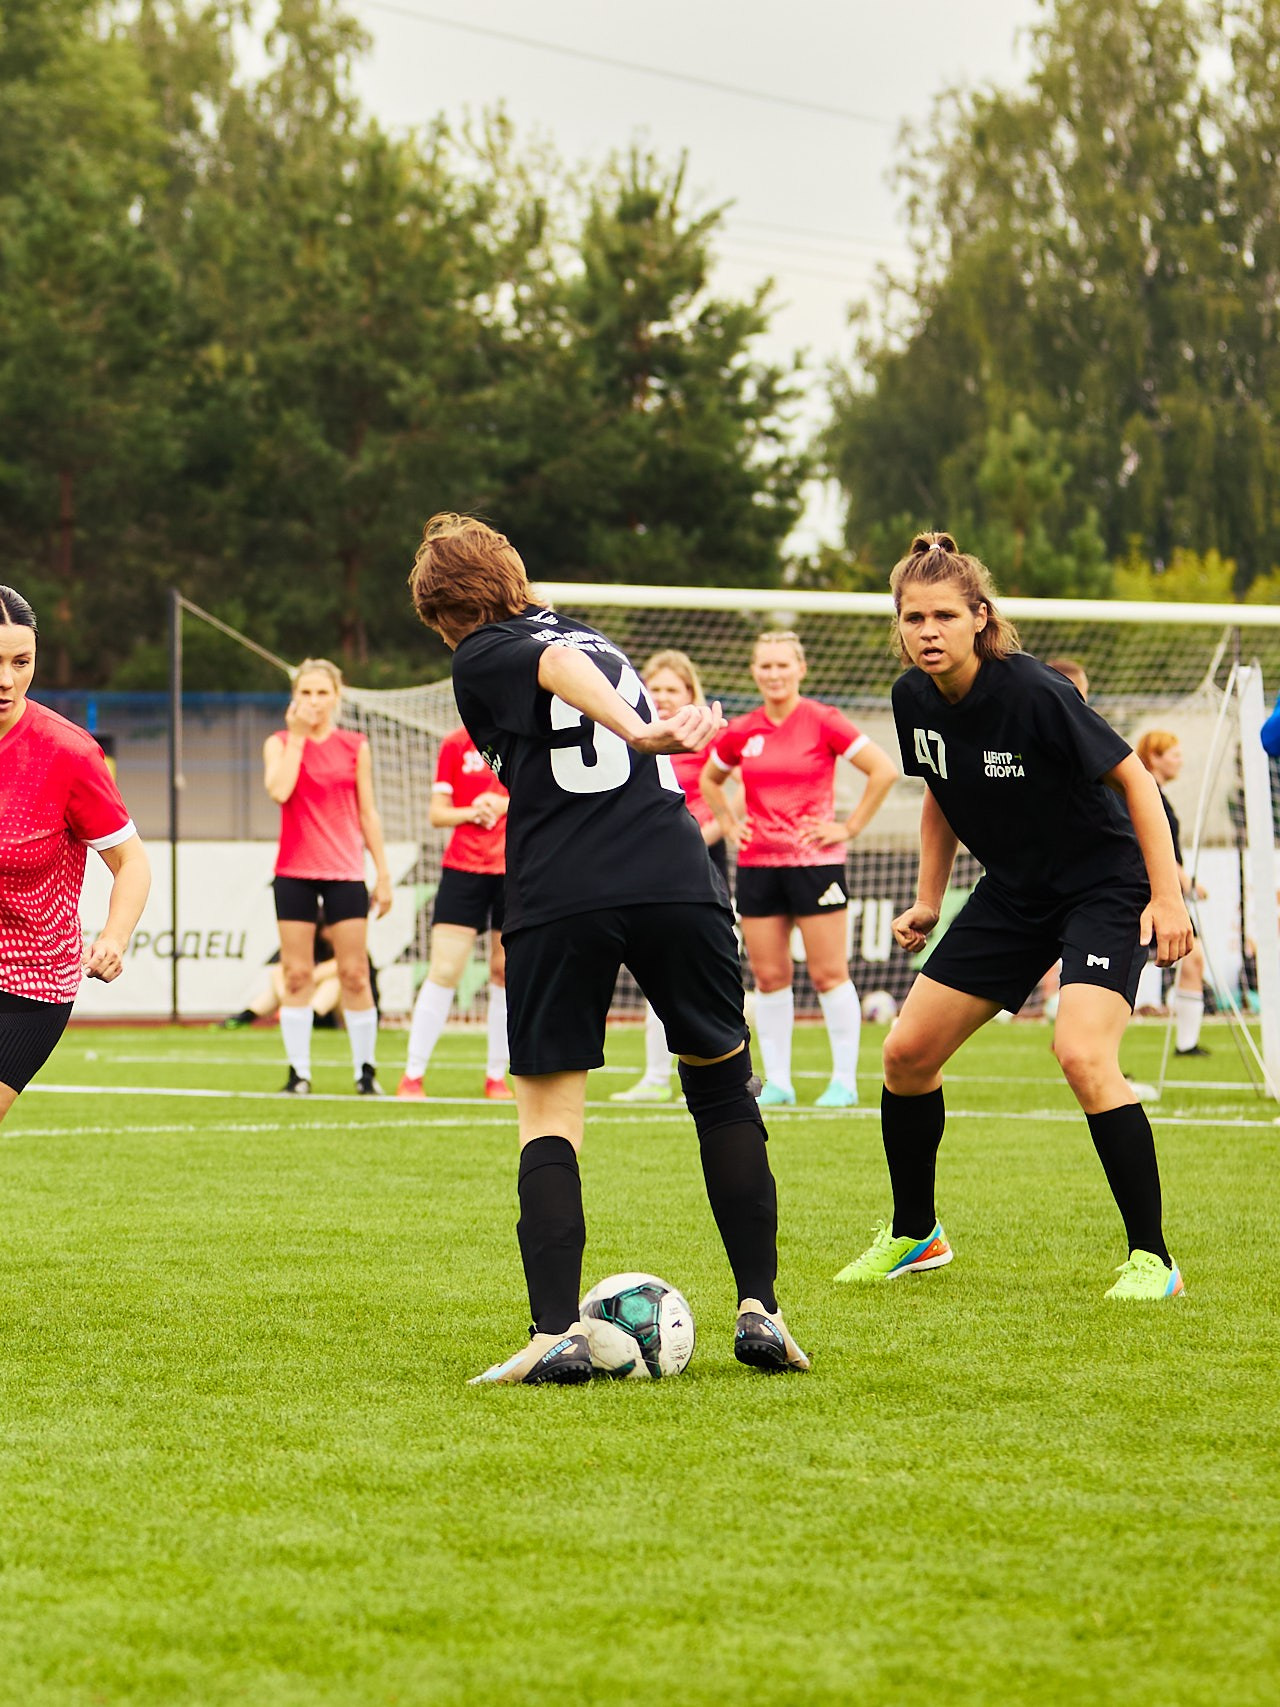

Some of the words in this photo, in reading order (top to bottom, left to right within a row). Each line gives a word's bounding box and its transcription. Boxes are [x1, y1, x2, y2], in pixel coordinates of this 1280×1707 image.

[913, 727, 948, 780] 47
[983, 750, 1013, 765] ЦЕНТР
[984, 764, 1025, 778] СПОРТА
